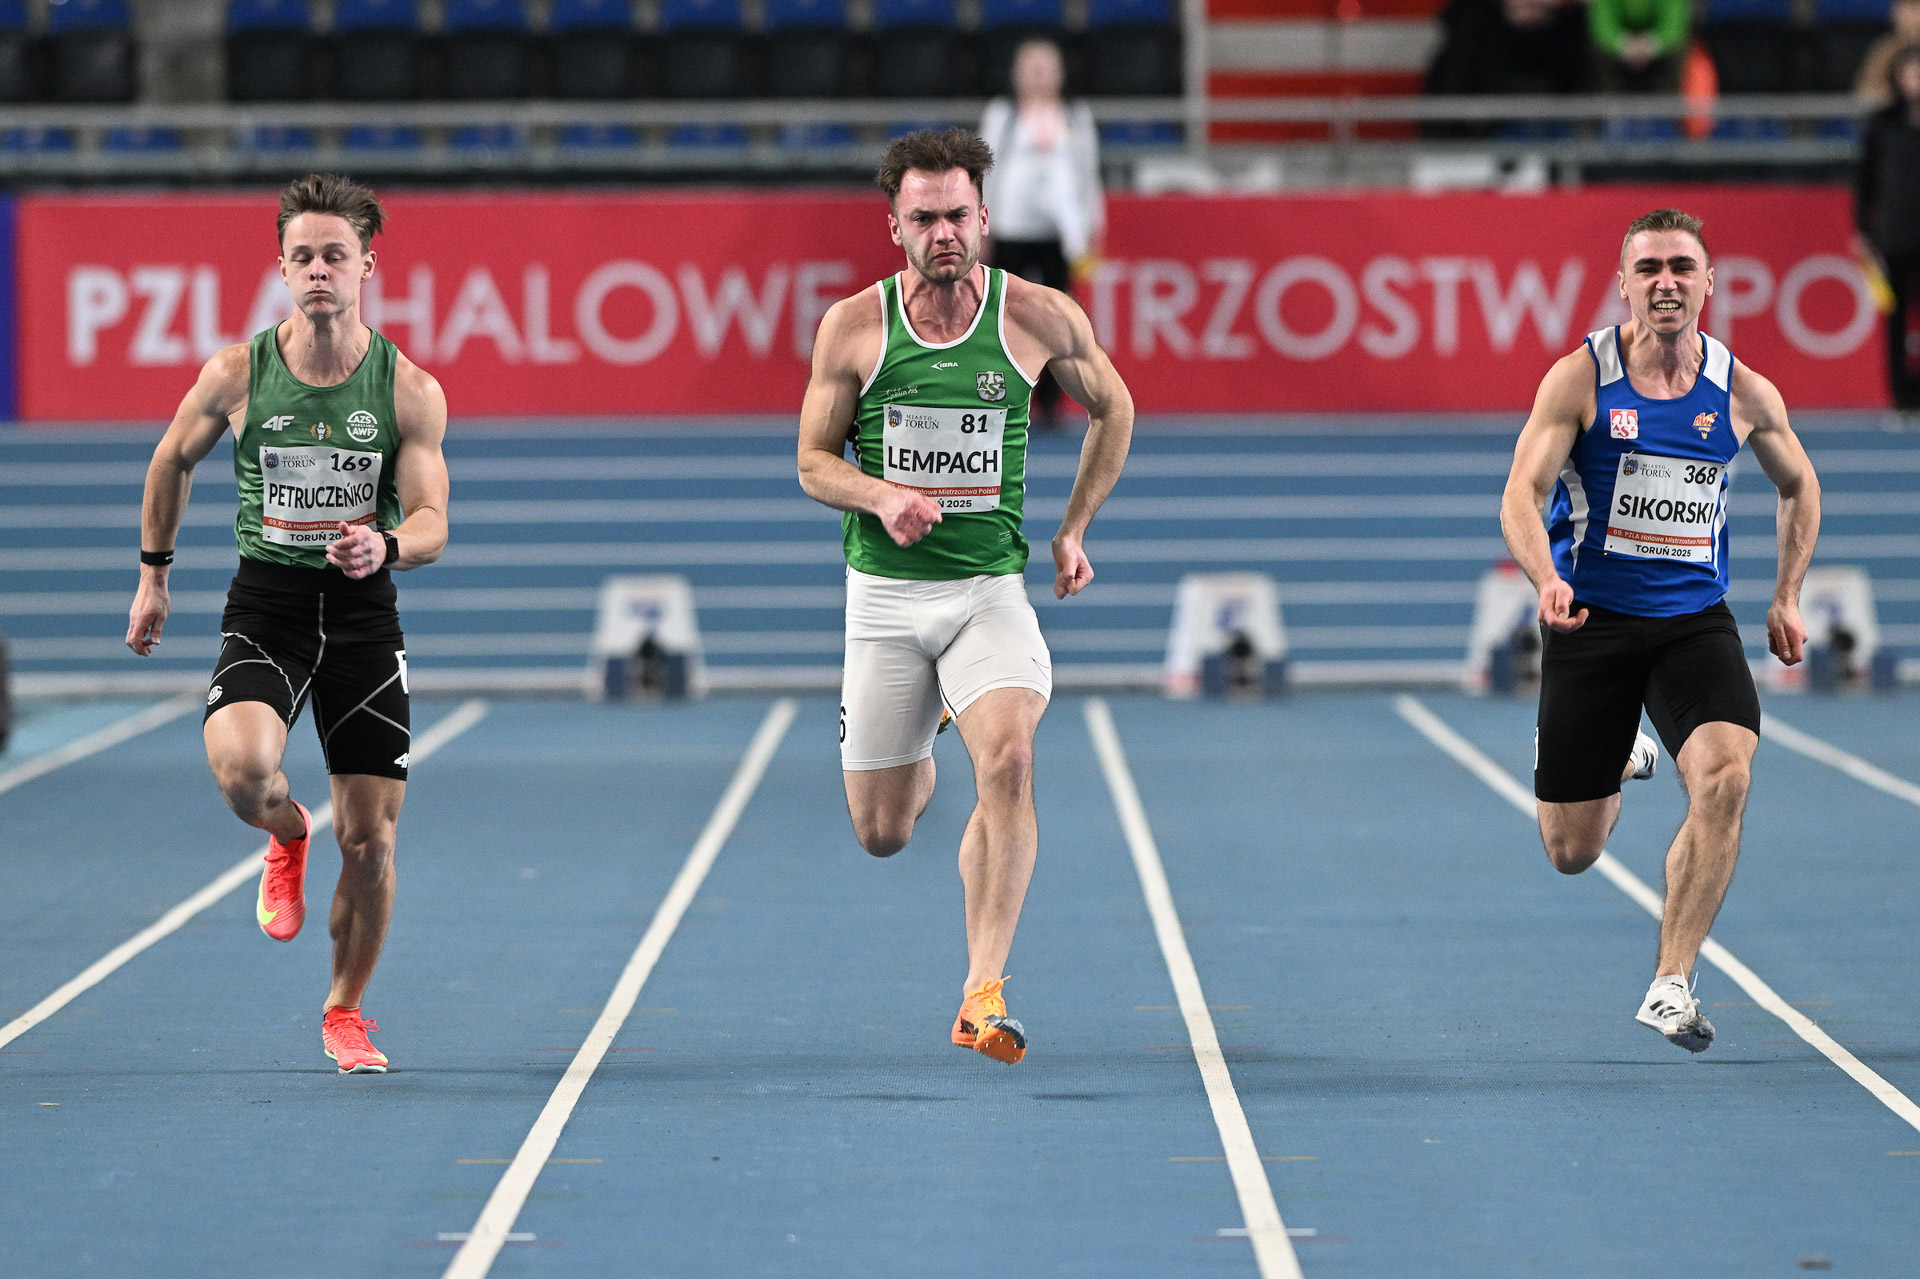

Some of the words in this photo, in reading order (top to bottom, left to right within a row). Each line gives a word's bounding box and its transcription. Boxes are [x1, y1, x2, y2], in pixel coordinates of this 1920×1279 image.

[1090, 258, 1630, 360] TRZOSTW
[1708, 254, 1880, 358] PO
[261, 415, 295, 431] 4F
[354, 415, 372, 424] AZS
[905, 418, 940, 429] TORUŃ
[961, 414, 988, 434] 81
[353, 427, 374, 437] AWF
[281, 457, 316, 468] TORUŃ
[331, 453, 372, 472] 169
[888, 445, 998, 474] LEMPACH
[1640, 467, 1672, 478] TORUŃ
[1684, 464, 1718, 485] 368
[269, 482, 374, 509] PETRUCZEŃKO
[938, 488, 977, 496] Mistrzostwa
[947, 500, 972, 508] 2025
[1617, 494, 1714, 524] SIKORSKI
[294, 522, 319, 530] Halowe
[290, 531, 326, 541] TORUŃ
[329, 533, 346, 541] 20
[1613, 529, 1623, 537] 69.
[1665, 537, 1696, 545] Mistrzostwa
[1636, 544, 1669, 556] TORUŃ
[1671, 548, 1691, 557] 2025
